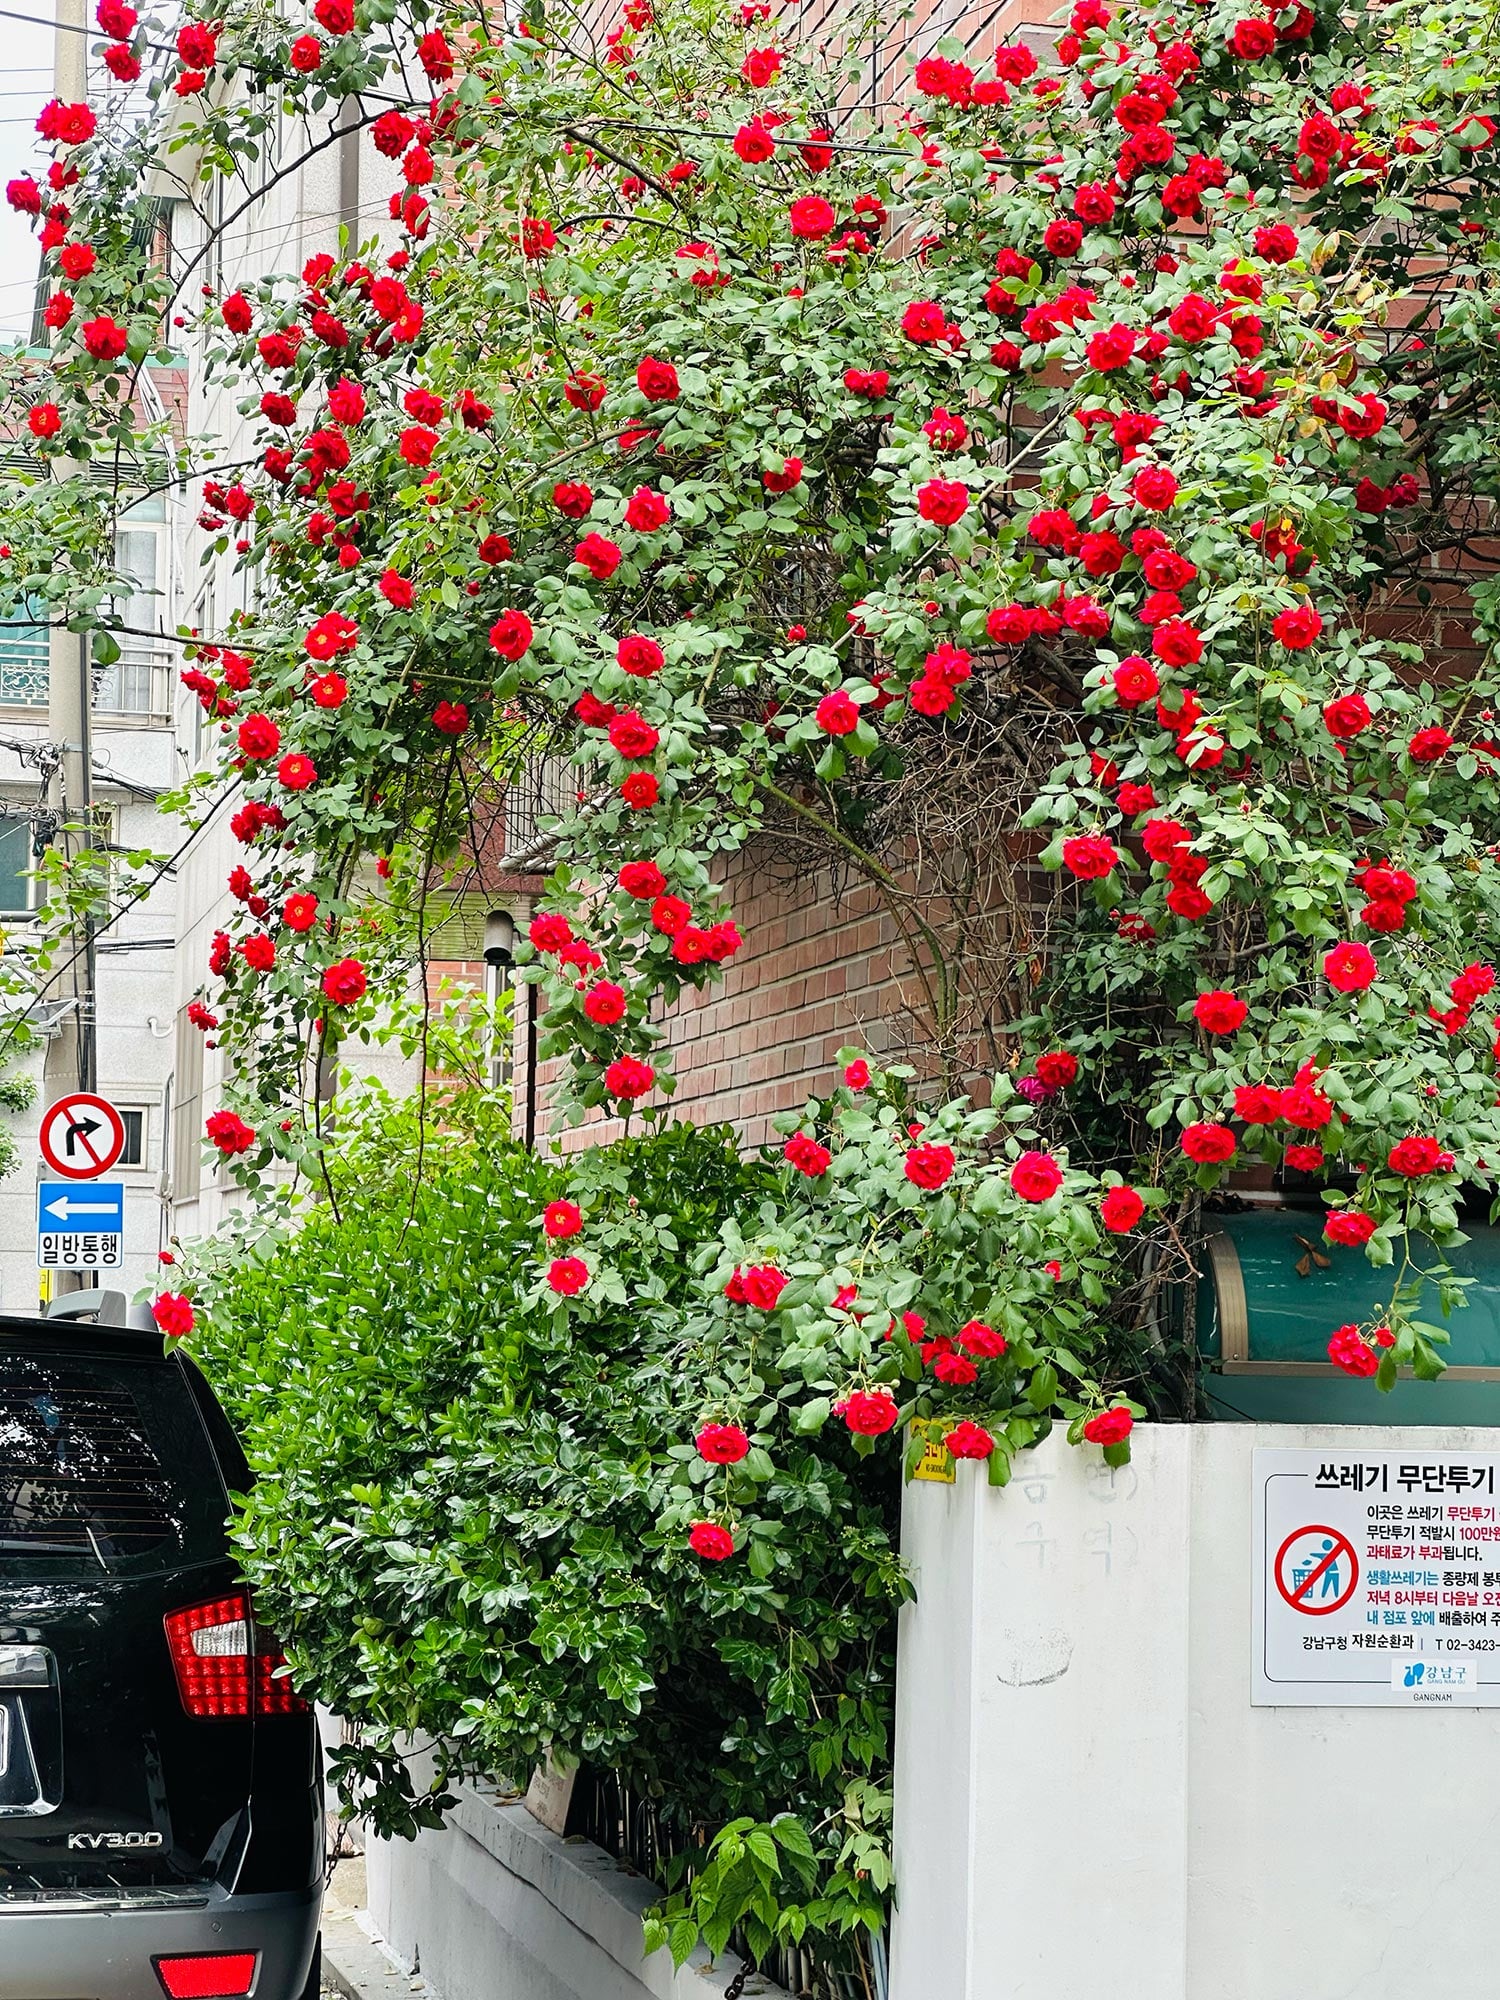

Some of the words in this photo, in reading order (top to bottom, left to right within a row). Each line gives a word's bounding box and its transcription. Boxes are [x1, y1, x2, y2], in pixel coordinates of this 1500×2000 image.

[43, 1234, 118, 1265] 일방통행
[1314, 1463, 1388, 1493] 쓰레기
[1396, 1465, 1494, 1495] 무단투기
[1366, 1505, 1404, 1521] 이곳은
[1407, 1505, 1444, 1522] 쓰레기
[1447, 1505, 1496, 1523] 무단투기
[1366, 1524, 1415, 1541] 무단투기
[1418, 1525, 1455, 1542] 적발시
[1366, 1544, 1415, 1561] 과태료가
[1417, 1544, 1484, 1562] 부과됩니다.
[1366, 1569, 1440, 1587] 생활쓰레기는
[1441, 1571, 1479, 1588] 종량제
[1366, 1589, 1391, 1606] 저녁
[1394, 1589, 1438, 1607] 8시부터
[1442, 1590, 1480, 1607] 다음날
[1366, 1609, 1379, 1626] 내
[1382, 1609, 1408, 1626] 점포
[1410, 1610, 1436, 1627] 앞에
[1438, 1610, 1487, 1627] 배출하여
[1302, 1636, 1348, 1652] 강남구청
[1351, 1633, 1415, 1650] 자원순환과
[1434, 1638, 1444, 1651] T
[1426, 1666, 1467, 1679] 강남구
[1413, 1692, 1452, 1702] GANGNAM
